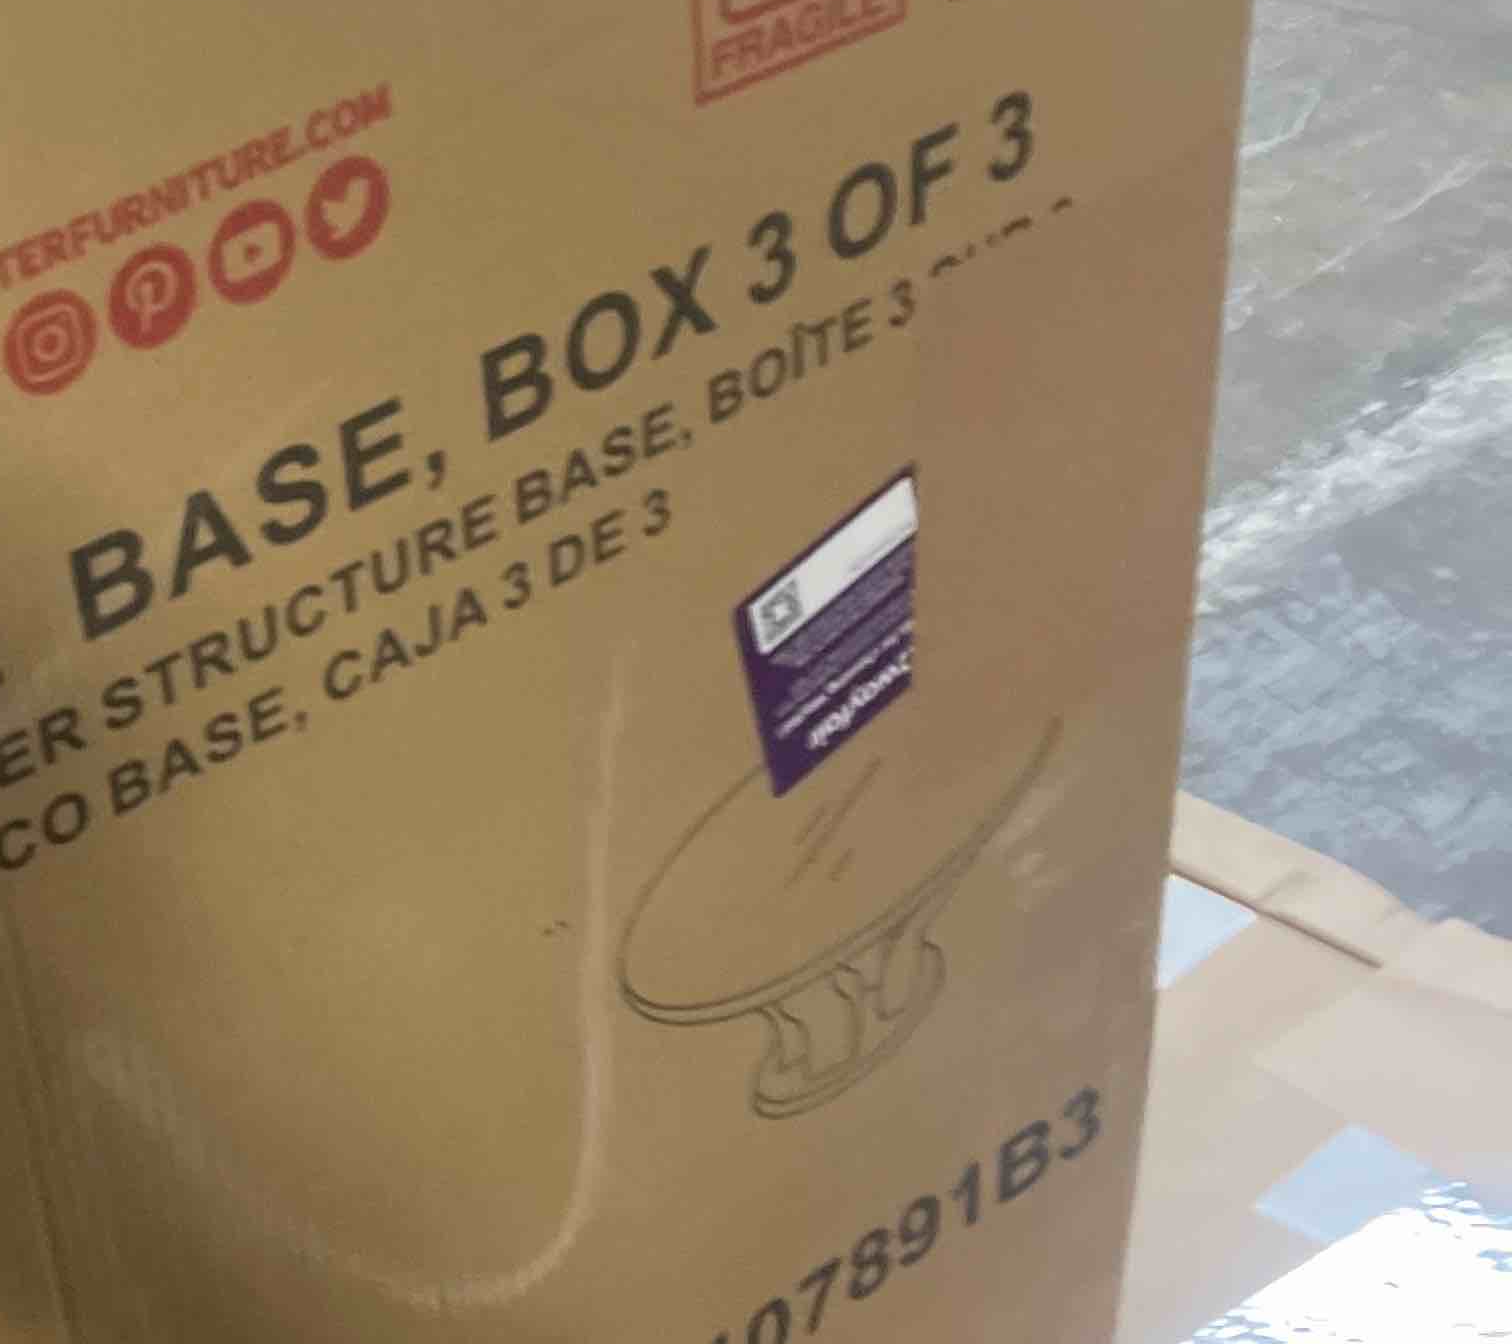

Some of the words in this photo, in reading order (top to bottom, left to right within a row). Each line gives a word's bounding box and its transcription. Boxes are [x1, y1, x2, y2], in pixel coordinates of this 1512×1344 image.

[68, 394, 447, 643] BASE,
[479, 244, 717, 443] BOX
[746, 210, 798, 306] 3
[826, 122, 961, 262] OF
[986, 90, 1034, 182] 3
[99, 492, 503, 735] STRUCTURE
[888, 278, 918, 330] 3
[105, 685, 313, 819] BASE,
[320, 585, 491, 702] CAJA
[501, 561, 533, 612] 3
[546, 508, 630, 588] DE
[643, 487, 673, 540] 3
